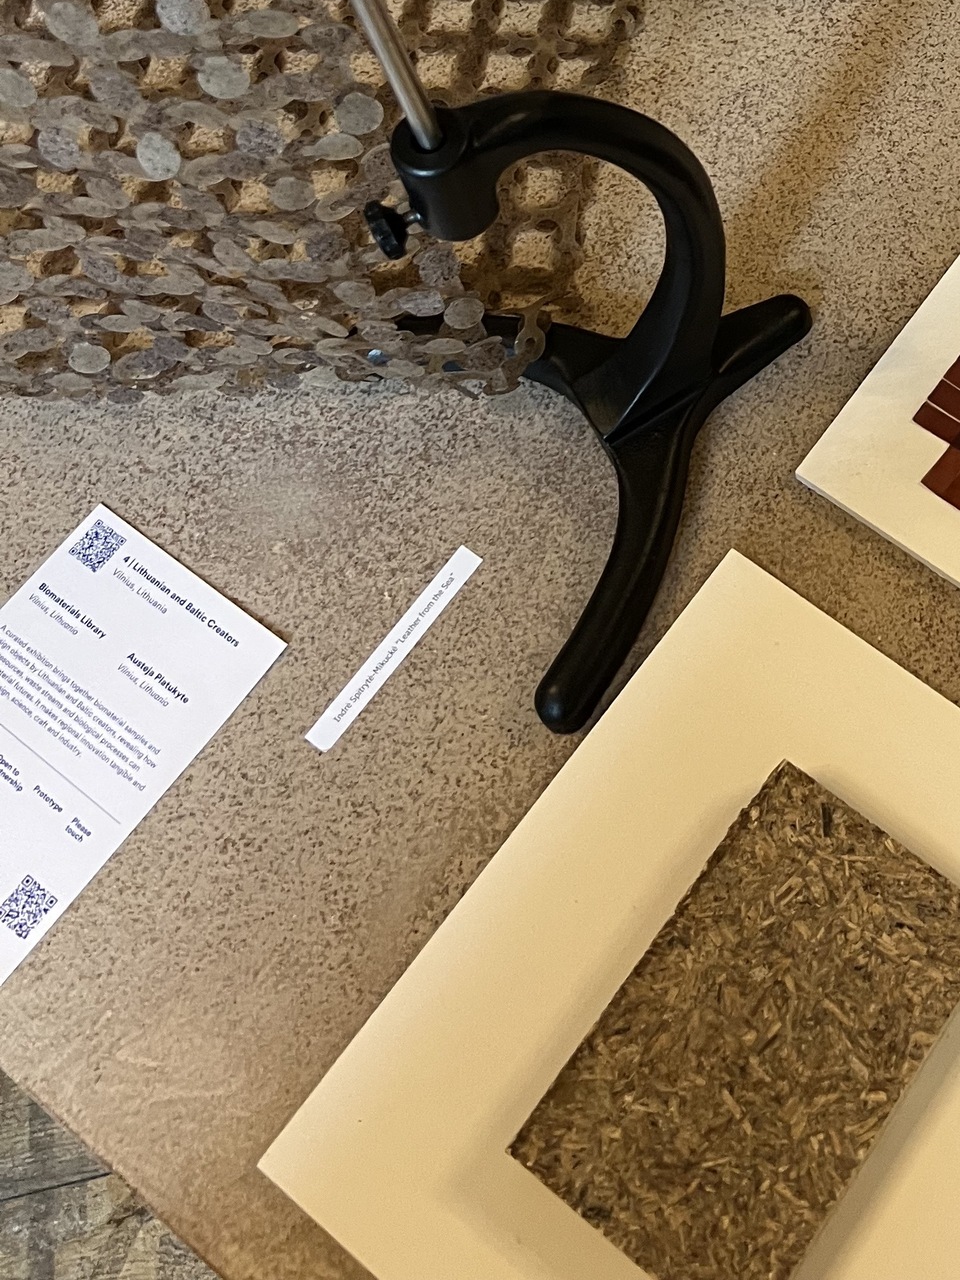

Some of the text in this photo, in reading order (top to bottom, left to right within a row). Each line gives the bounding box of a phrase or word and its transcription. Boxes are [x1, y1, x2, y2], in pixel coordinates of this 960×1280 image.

[113, 568, 168, 614] Vilnius, Lithuania
[132, 562, 171, 595] Lithuanian
[170, 593, 188, 606] and
[185, 602, 207, 622] Baltic
[207, 619, 239, 647] Creators
[418, 601, 435, 618] from
[432, 589, 444, 602] the
[38, 582, 106, 639] Biomaterials Library
[49, 610, 79, 635] Lithuania
[5, 629, 29, 648] curated
[26, 646, 54, 669] exhibition
[52, 665, 71, 684] brings
[70, 680, 95, 702] together
[93, 698, 127, 727] biomaterial
[124, 725, 148, 746] samples
[147, 744, 161, 755] and
[139, 680, 169, 707] Lithuania
[9, 649, 31, 667] objects
[28, 662, 39, 674] by
[37, 669, 67, 695] Lithuanian
[65, 693, 79, 705] and
[76, 700, 94, 718] Baltic
[117, 735, 144, 760] revealing
[143, 755, 157, 768] how
[24, 676, 42, 692] waste
[40, 689, 63, 710] streams
[62, 707, 76, 718] and
[73, 714, 103, 740] biological
[99, 738, 129, 763] processes
[128, 760, 141, 772] can
[33, 715, 49, 729] craft
[47, 726, 61, 738] and
[33, 697, 41, 707] It
[39, 704, 58, 721] makes
[57, 719, 83, 740] regional
[80, 735, 110, 764] innovation
[109, 760, 133, 782] tangible
[132, 780, 146, 792] and
[11, 767, 20, 776] to
[33, 785, 63, 813] Prototype
[65, 825, 83, 843] touch
[71, 817, 92, 837] Please
